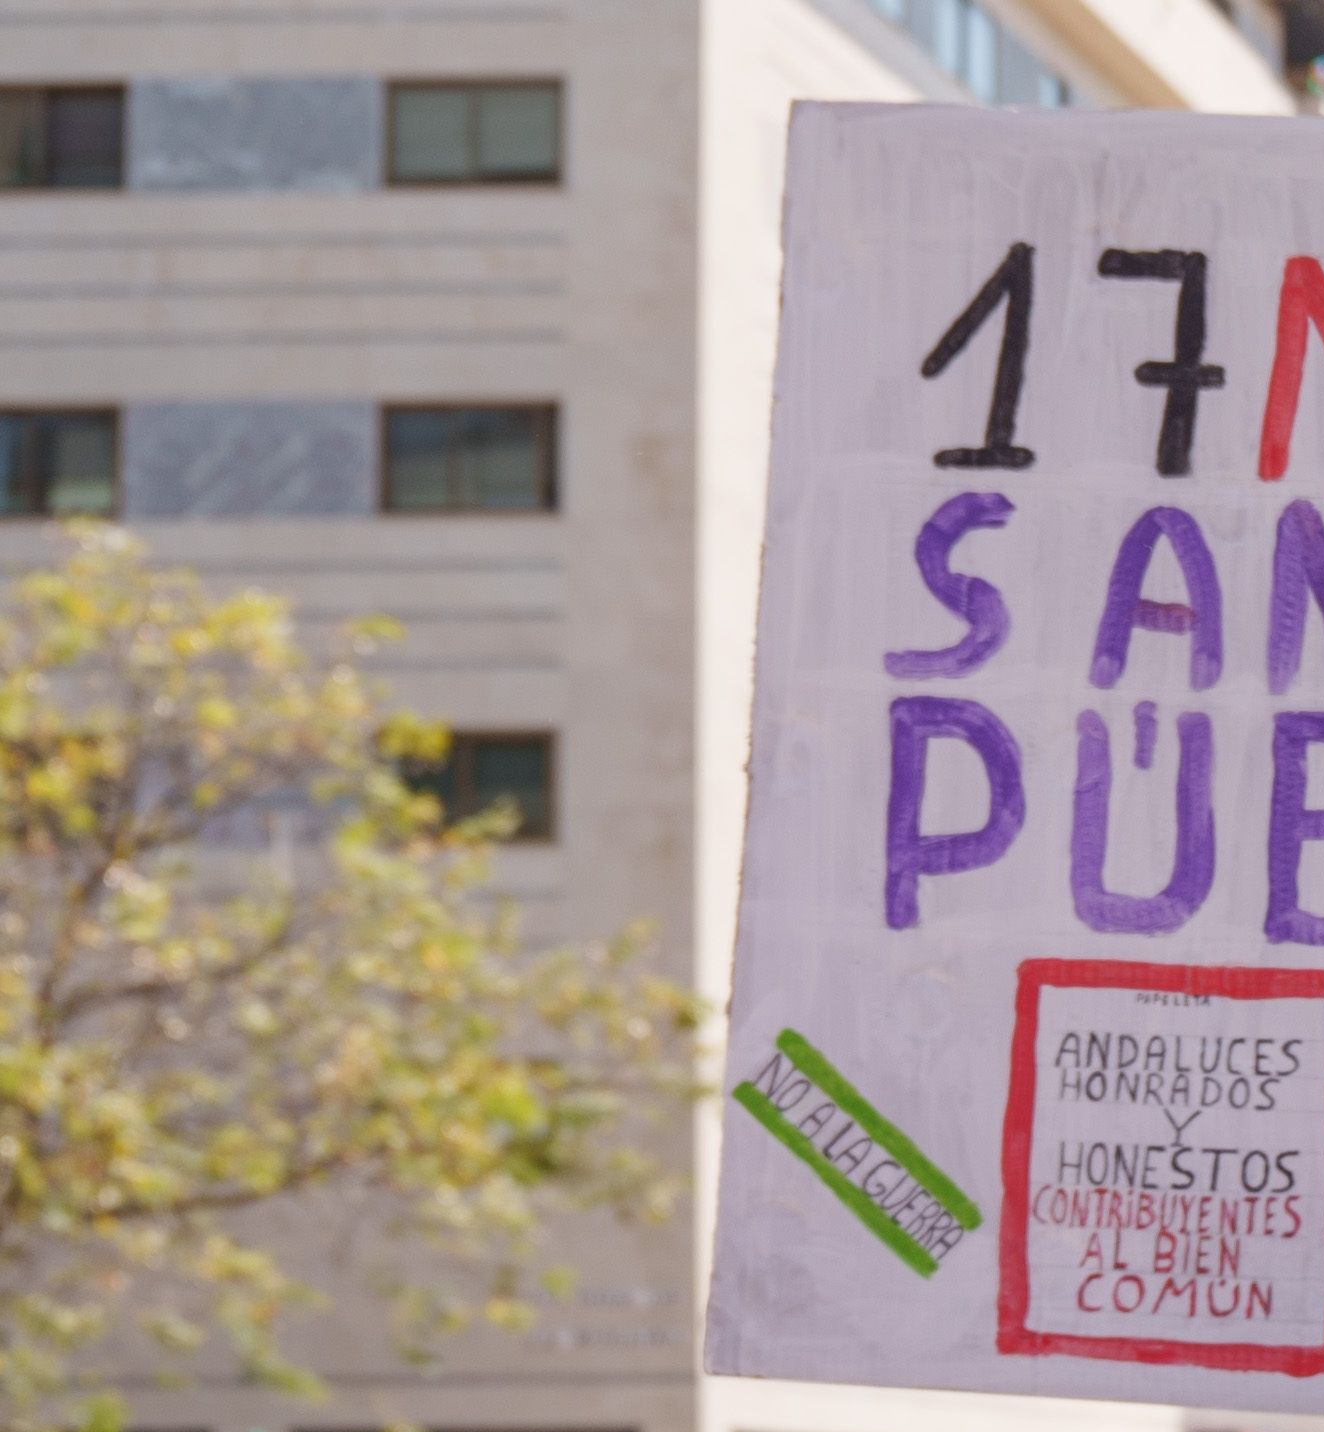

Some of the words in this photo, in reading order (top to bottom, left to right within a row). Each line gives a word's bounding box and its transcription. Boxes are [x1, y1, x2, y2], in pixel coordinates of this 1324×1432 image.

[1054, 1032, 1303, 1077] ANDALUCES
[1060, 1069, 1280, 1111] HONRADOS
[1163, 1108, 1202, 1148] Y
[752, 1053, 811, 1112] NO
[797, 1102, 836, 1140] A
[822, 1120, 873, 1176] LA
[862, 1160, 964, 1261] GUERRA
[1057, 1141, 1300, 1193] HONESTOS
[1079, 1227, 1128, 1270] AL
[1153, 1231, 1242, 1278] BIEN
[1077, 1273, 1274, 1320] COMÚN
